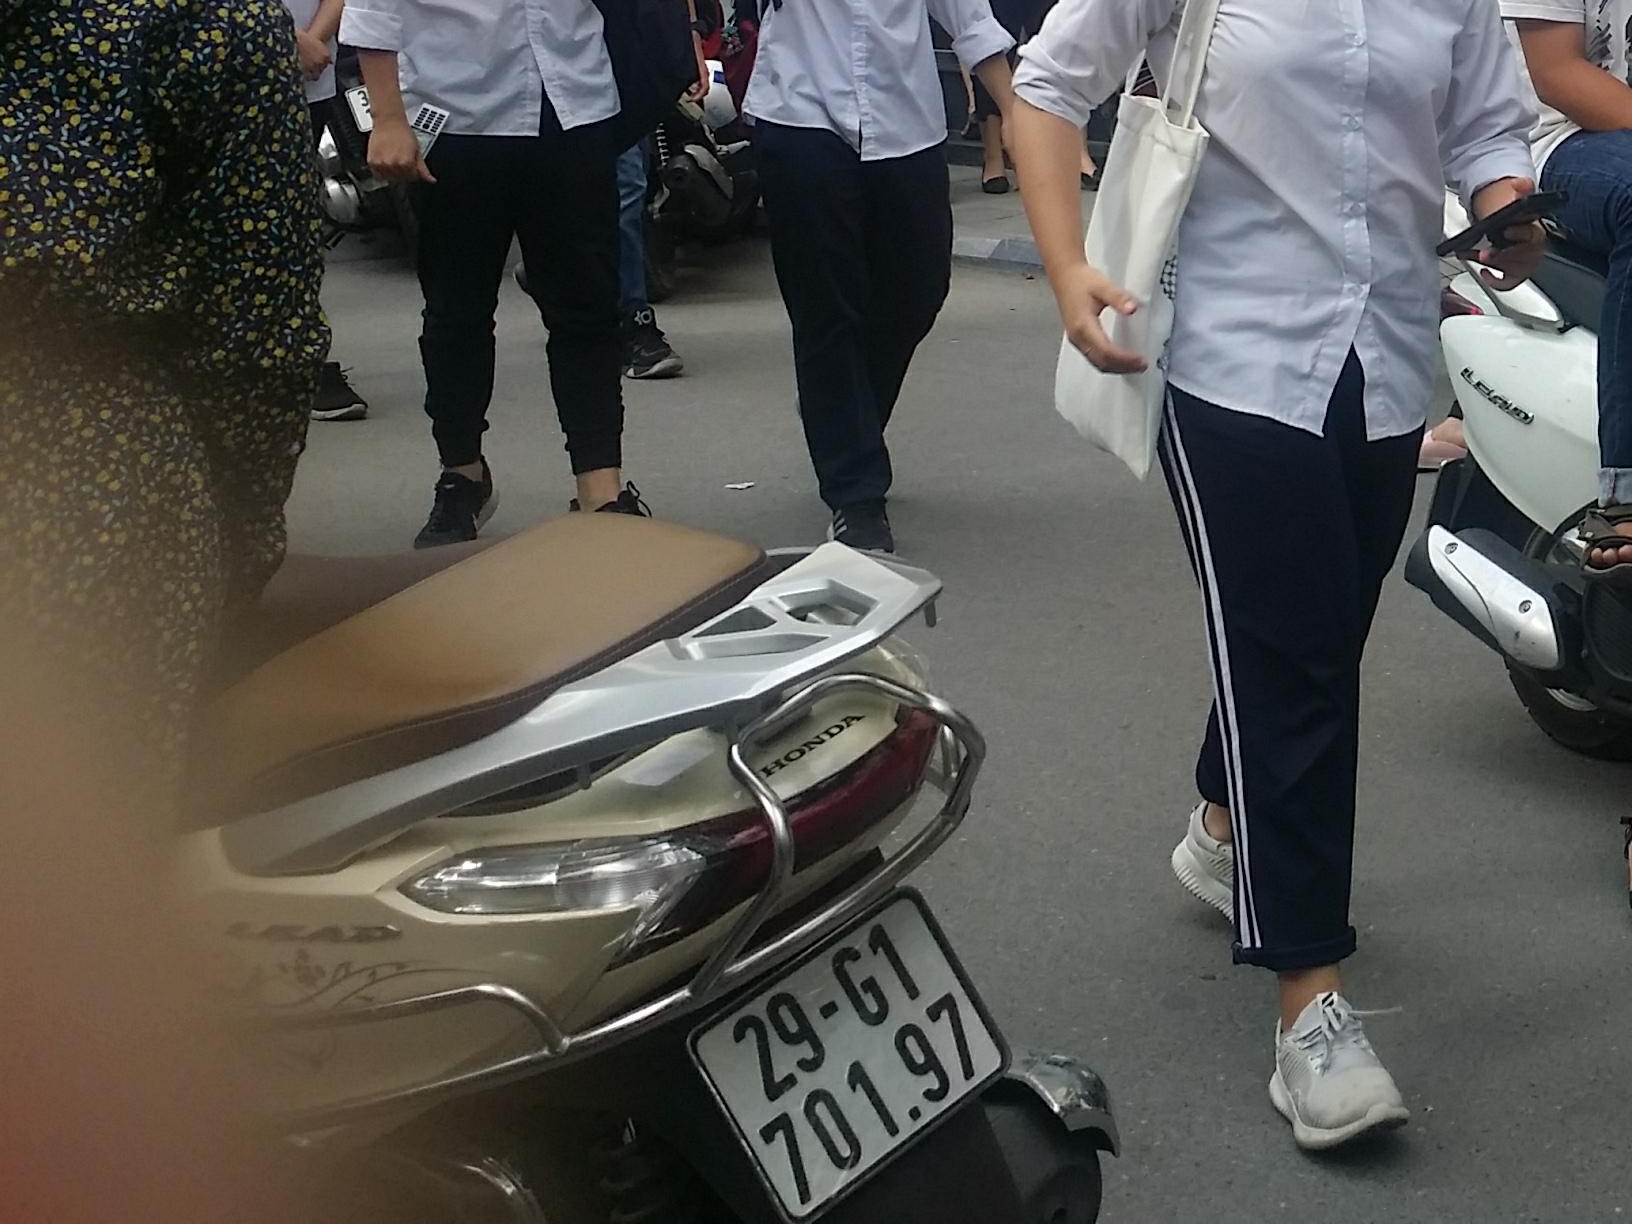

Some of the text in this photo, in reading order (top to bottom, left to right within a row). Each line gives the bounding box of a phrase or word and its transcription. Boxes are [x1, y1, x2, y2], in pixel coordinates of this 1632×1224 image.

[760, 712, 865, 778] HONDA
[732, 923, 920, 1103] 29-G1
[759, 993, 975, 1206] 701.97
